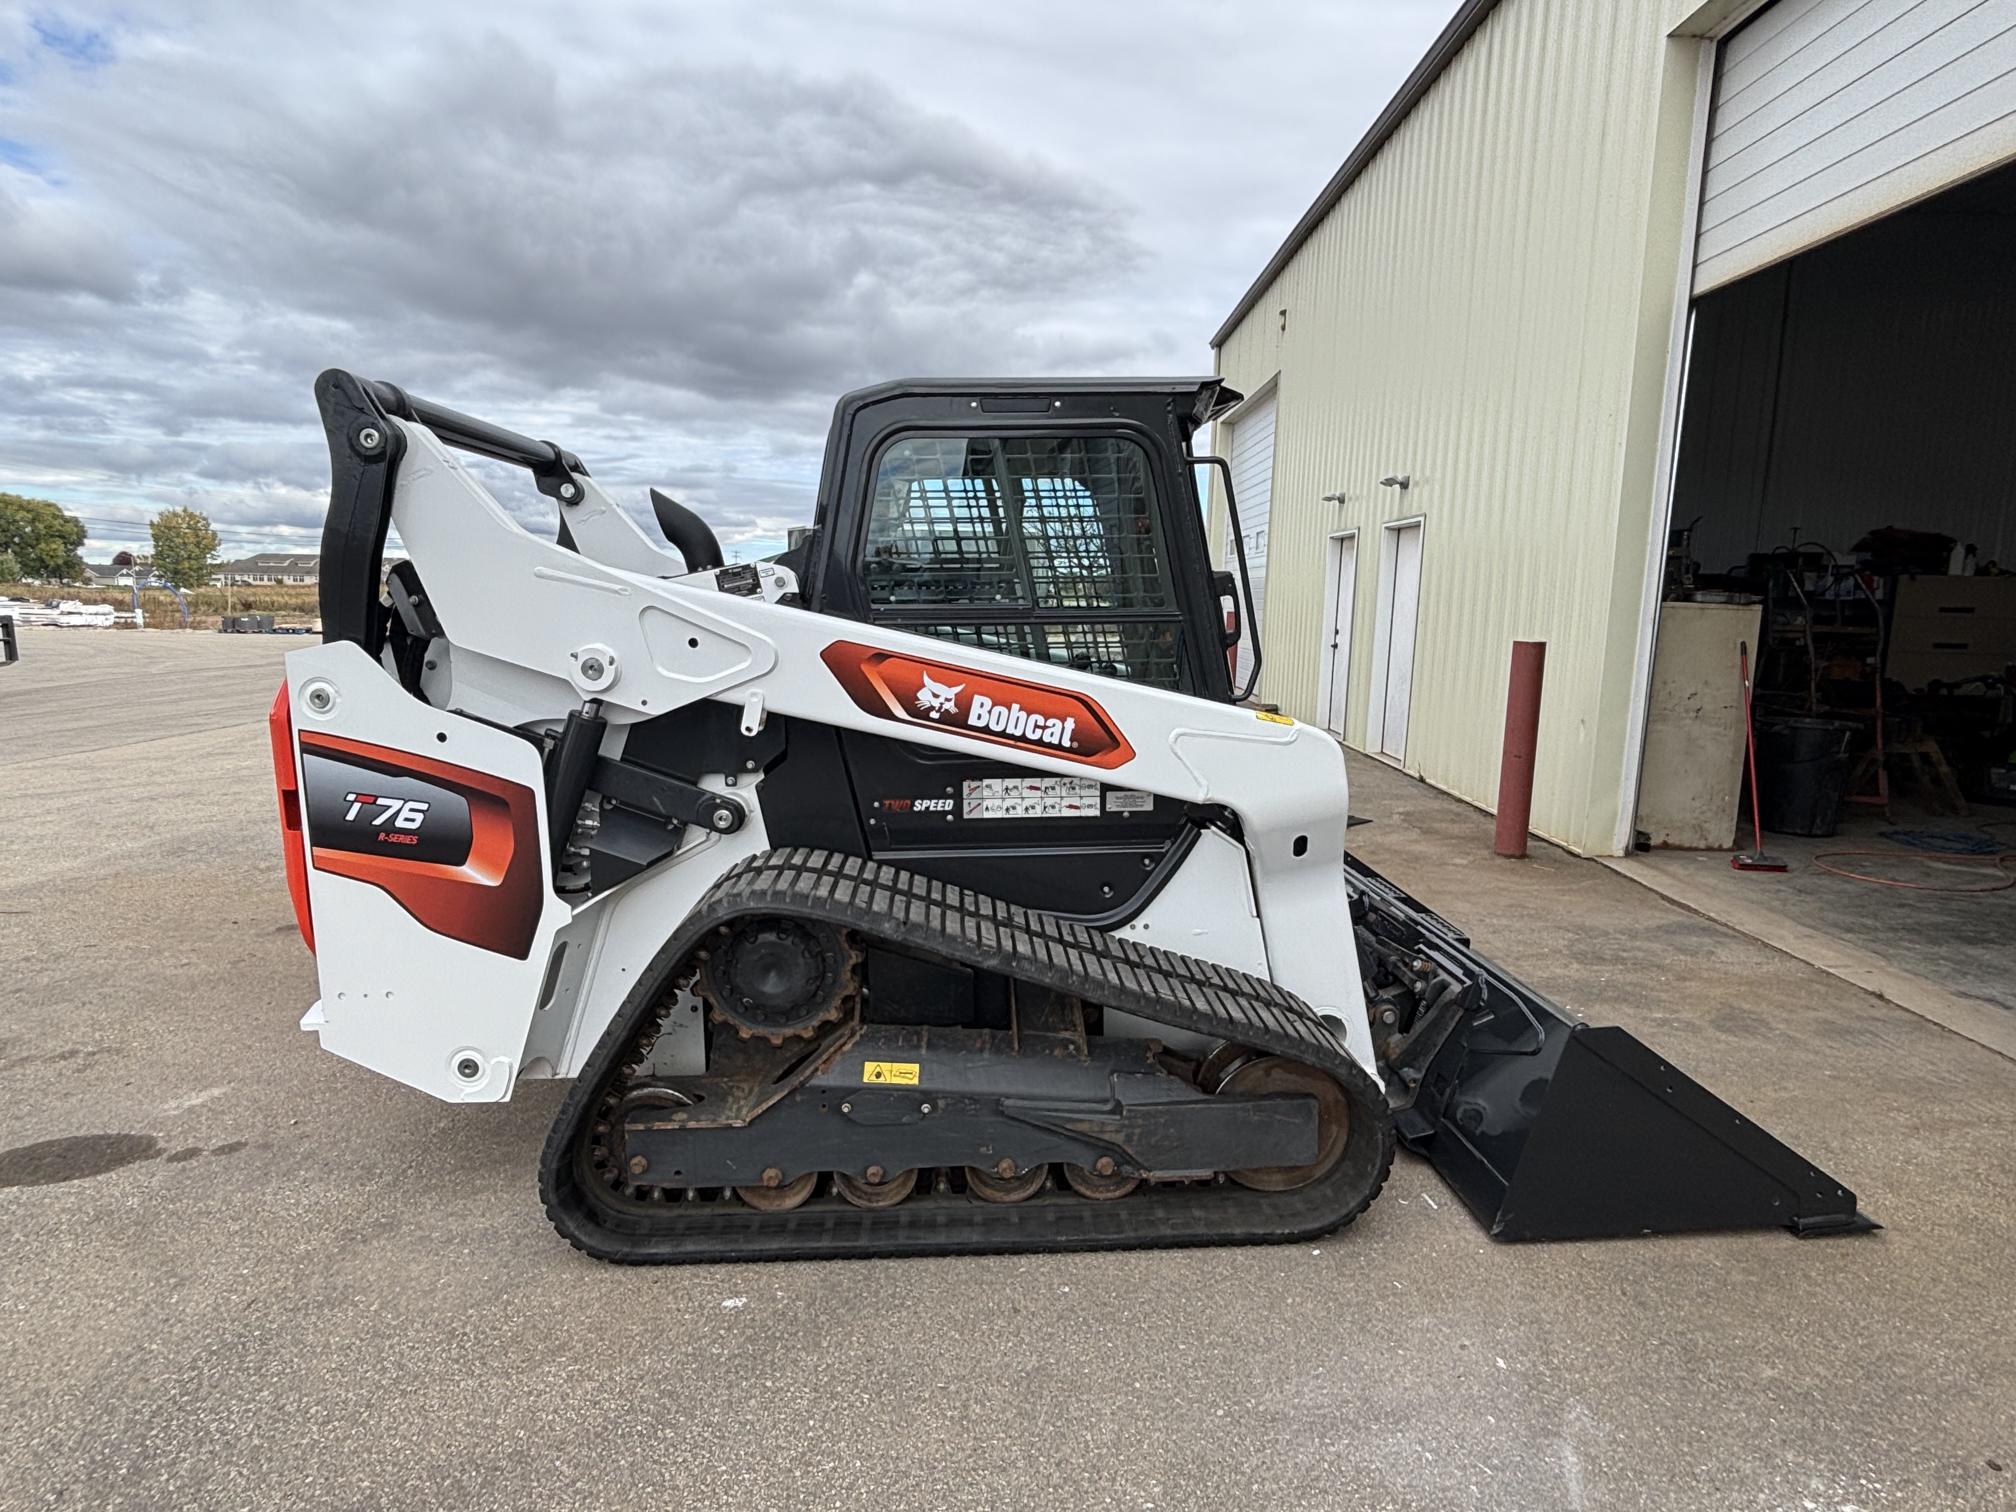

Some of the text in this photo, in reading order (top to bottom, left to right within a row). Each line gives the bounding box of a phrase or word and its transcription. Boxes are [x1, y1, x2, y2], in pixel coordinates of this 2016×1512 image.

[968, 694, 1075, 748] Bobcat
[345, 793, 430, 830] T76
[883, 799, 954, 812] TWO SPEED
[378, 832, 418, 844] R-SERIES
